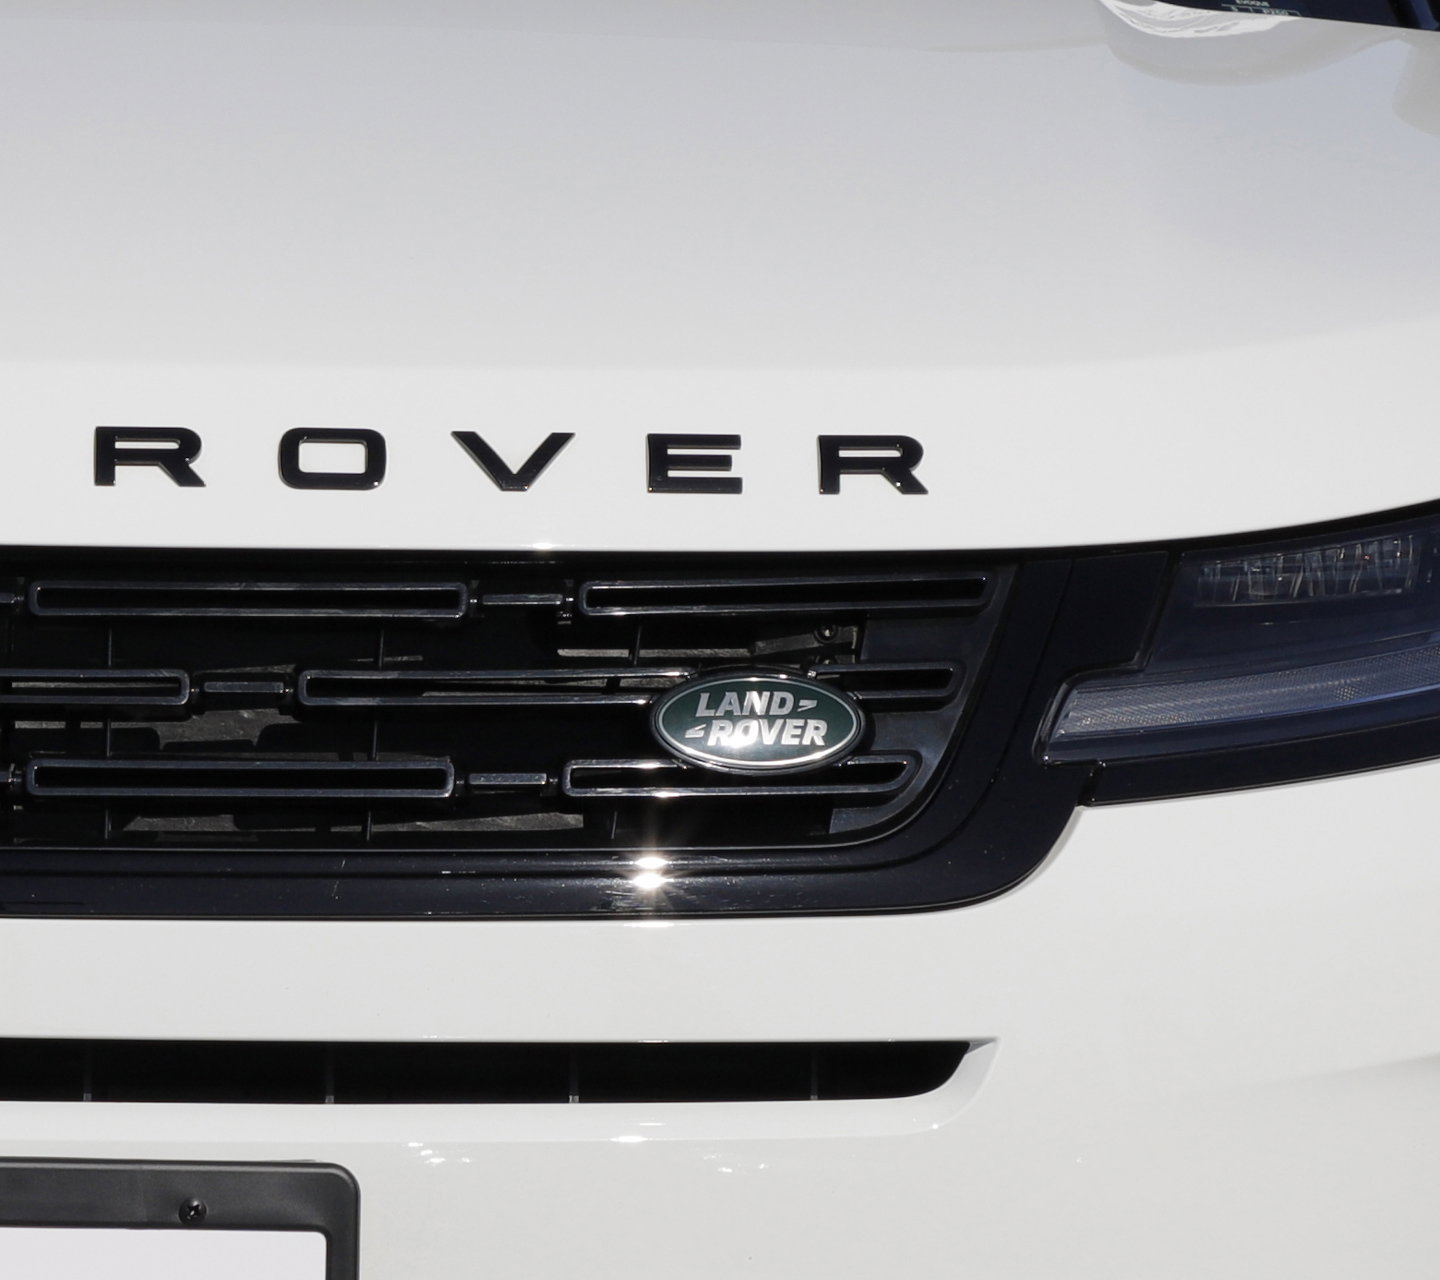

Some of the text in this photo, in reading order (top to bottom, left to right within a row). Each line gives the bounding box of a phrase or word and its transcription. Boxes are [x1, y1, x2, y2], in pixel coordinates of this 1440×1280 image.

[93, 426, 929, 495] ROVER
[695, 691, 795, 717] LAND
[707, 718, 828, 747] ROVER
